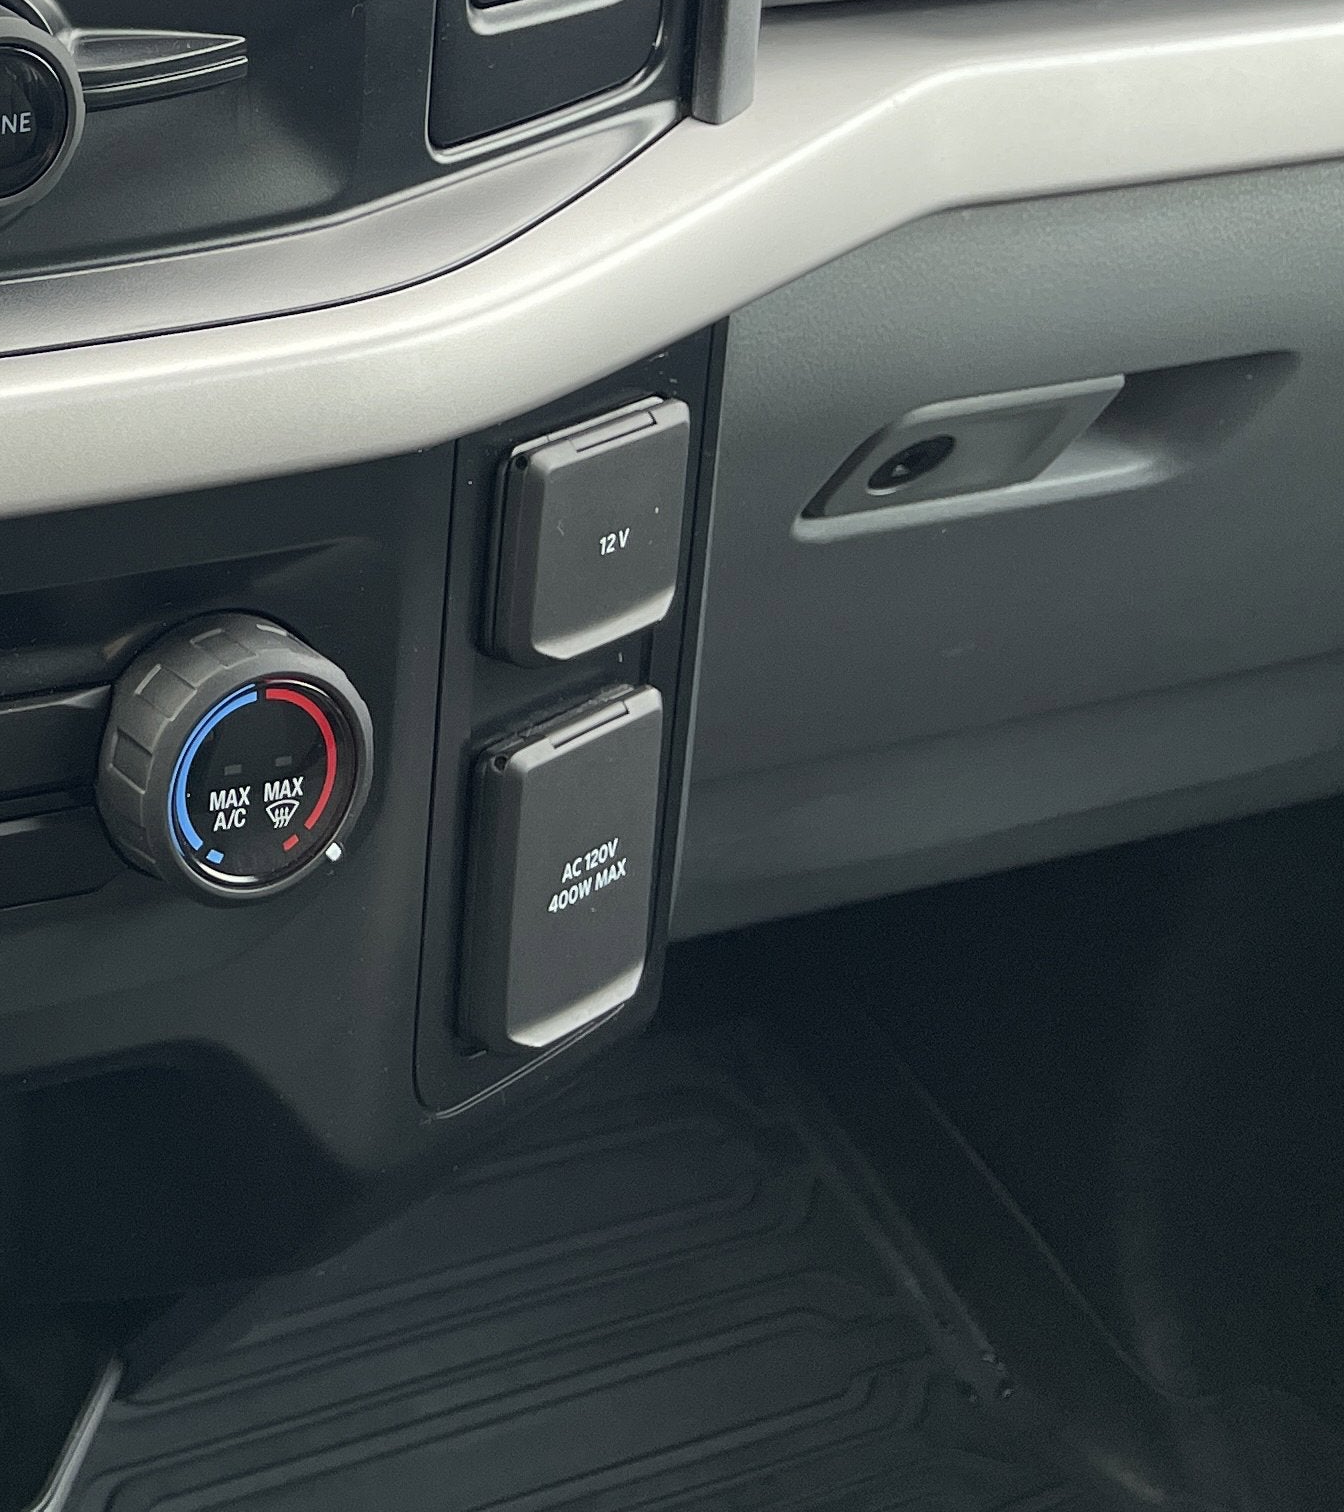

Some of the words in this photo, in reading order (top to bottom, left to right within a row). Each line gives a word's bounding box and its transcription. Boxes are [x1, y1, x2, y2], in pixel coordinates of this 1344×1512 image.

[208, 785, 252, 811] MAX
[263, 776, 305, 802] MAX
[213, 807, 247, 832] A/C
[562, 857, 582, 883] AC
[585, 838, 618, 870] 120V
[548, 877, 593, 913] 400W
[595, 857, 627, 891] MAX
